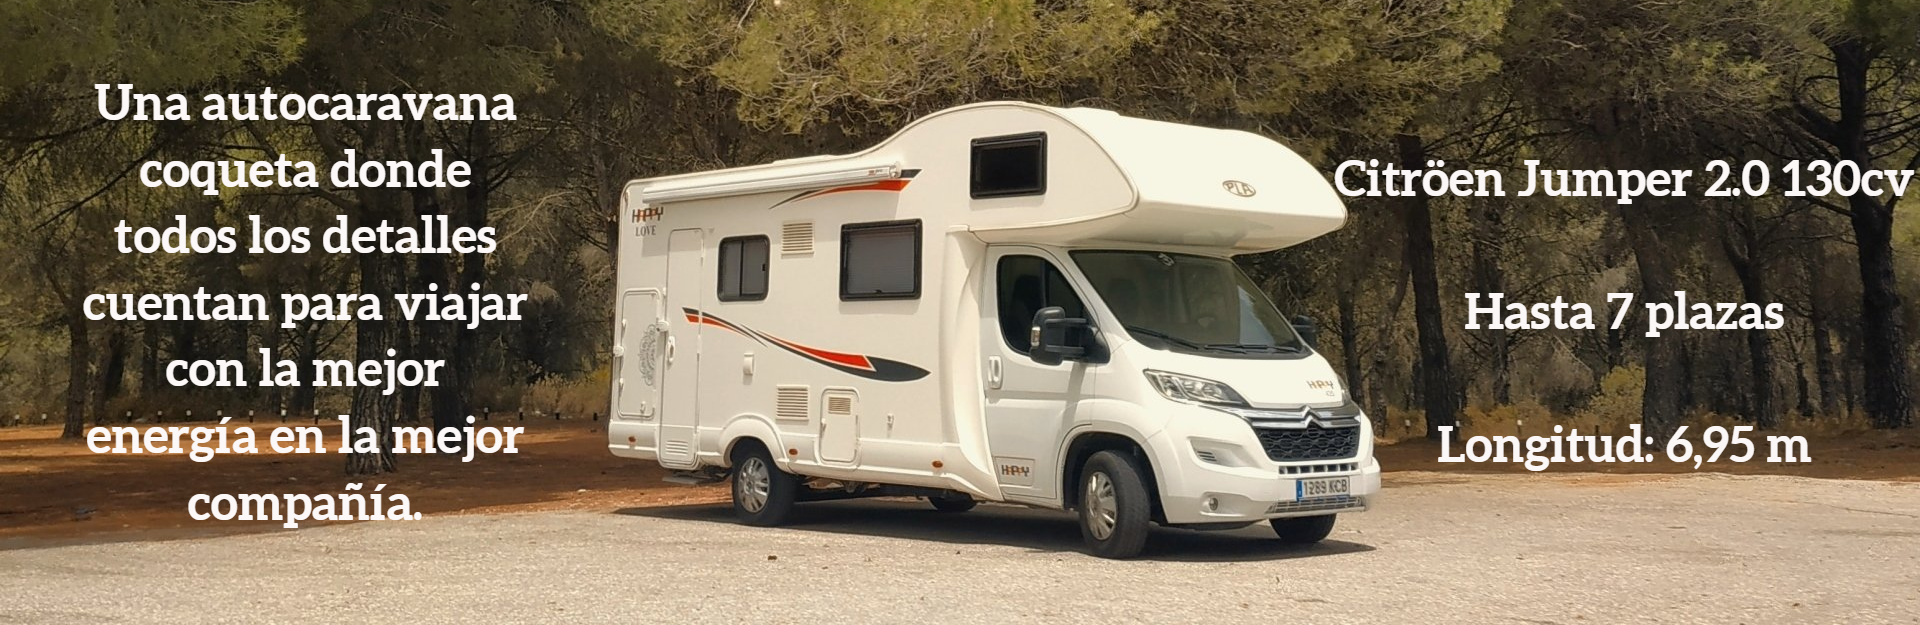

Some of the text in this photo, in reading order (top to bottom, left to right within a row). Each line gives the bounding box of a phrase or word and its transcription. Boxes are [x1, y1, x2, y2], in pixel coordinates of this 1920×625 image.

[1222, 180, 1256, 197] PLA
[635, 225, 657, 237] LOVE
[1304, 479, 1348, 495] 1289 KCB
